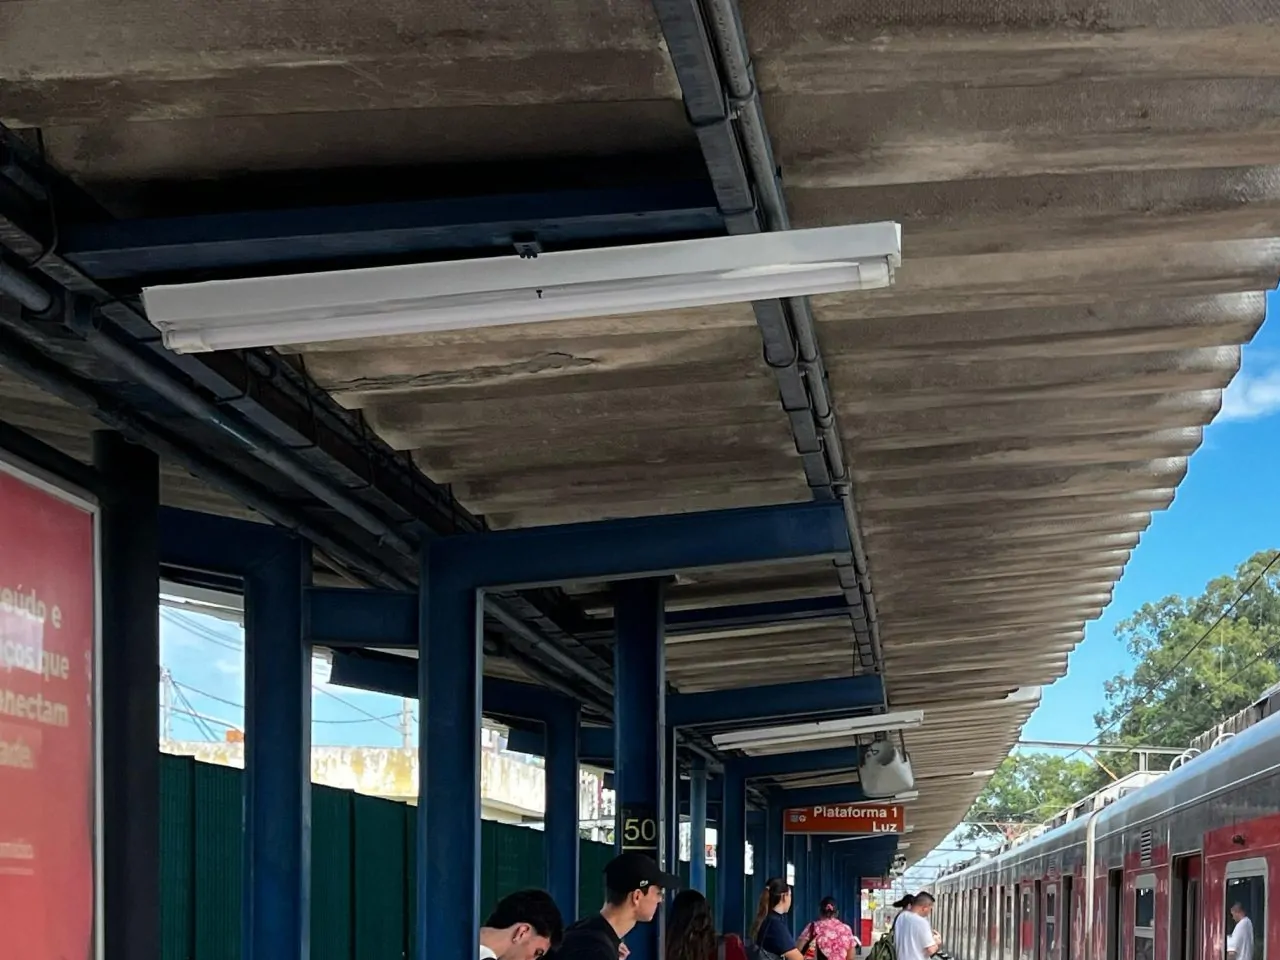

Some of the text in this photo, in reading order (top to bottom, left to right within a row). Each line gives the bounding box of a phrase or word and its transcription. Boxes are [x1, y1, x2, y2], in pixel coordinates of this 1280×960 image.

[0, 584, 62, 629] eúdo e
[42, 650, 69, 682] que
[0, 688, 69, 728] nectam
[813, 806, 888, 818] Plataforma
[891, 806, 898, 818] 1
[624, 818, 656, 841] 50
[872, 821, 897, 832] Luz
